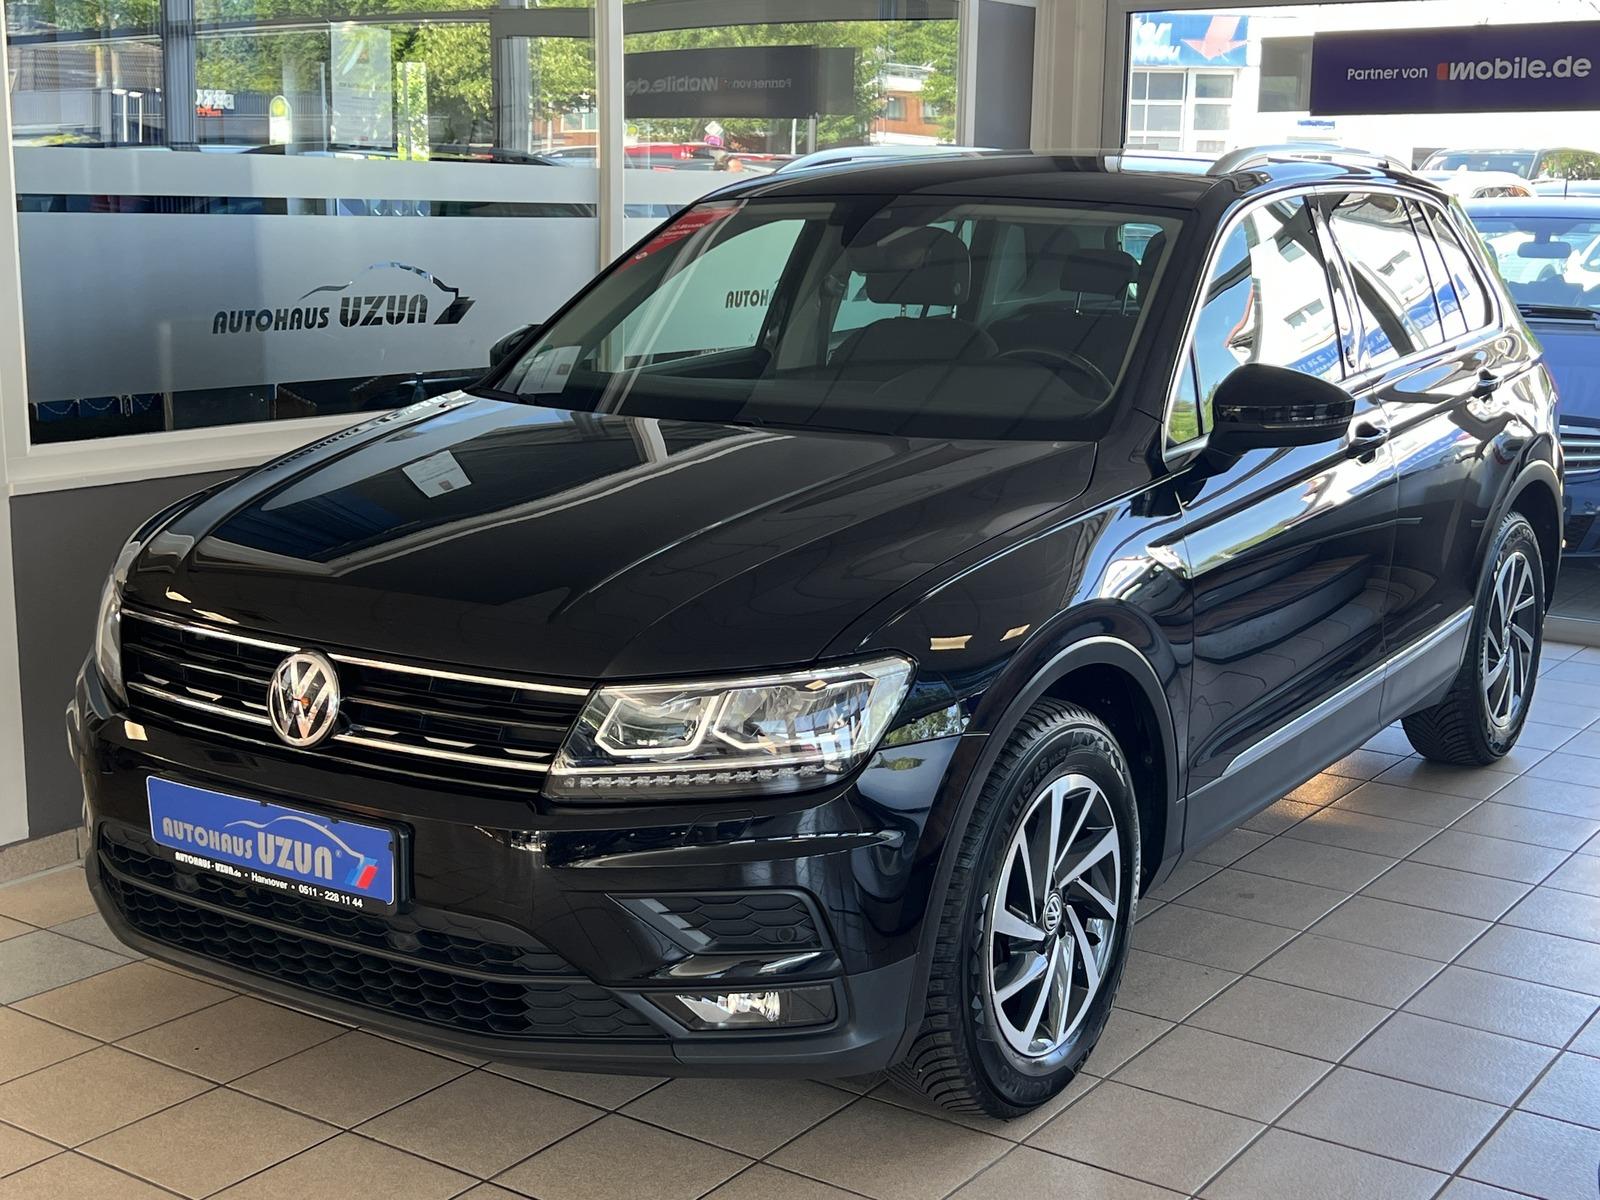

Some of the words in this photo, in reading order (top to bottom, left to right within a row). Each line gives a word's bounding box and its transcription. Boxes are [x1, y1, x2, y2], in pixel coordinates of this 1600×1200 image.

[1347, 68, 1399, 81] Partner
[1402, 68, 1428, 79] von
[1450, 56, 1592, 81] mobile.de
[212, 307, 330, 334] AUTOHAUS
[339, 294, 428, 327] UZUN
[725, 289, 770, 309] AUTOH
[162, 816, 253, 859] AUTOHAUS
[257, 831, 333, 881] UZUN
[251, 871, 288, 890] Hannover
[298, 883, 318, 897] 0511
[340, 894, 351, 905] 11
[351, 897, 364, 908] 44
